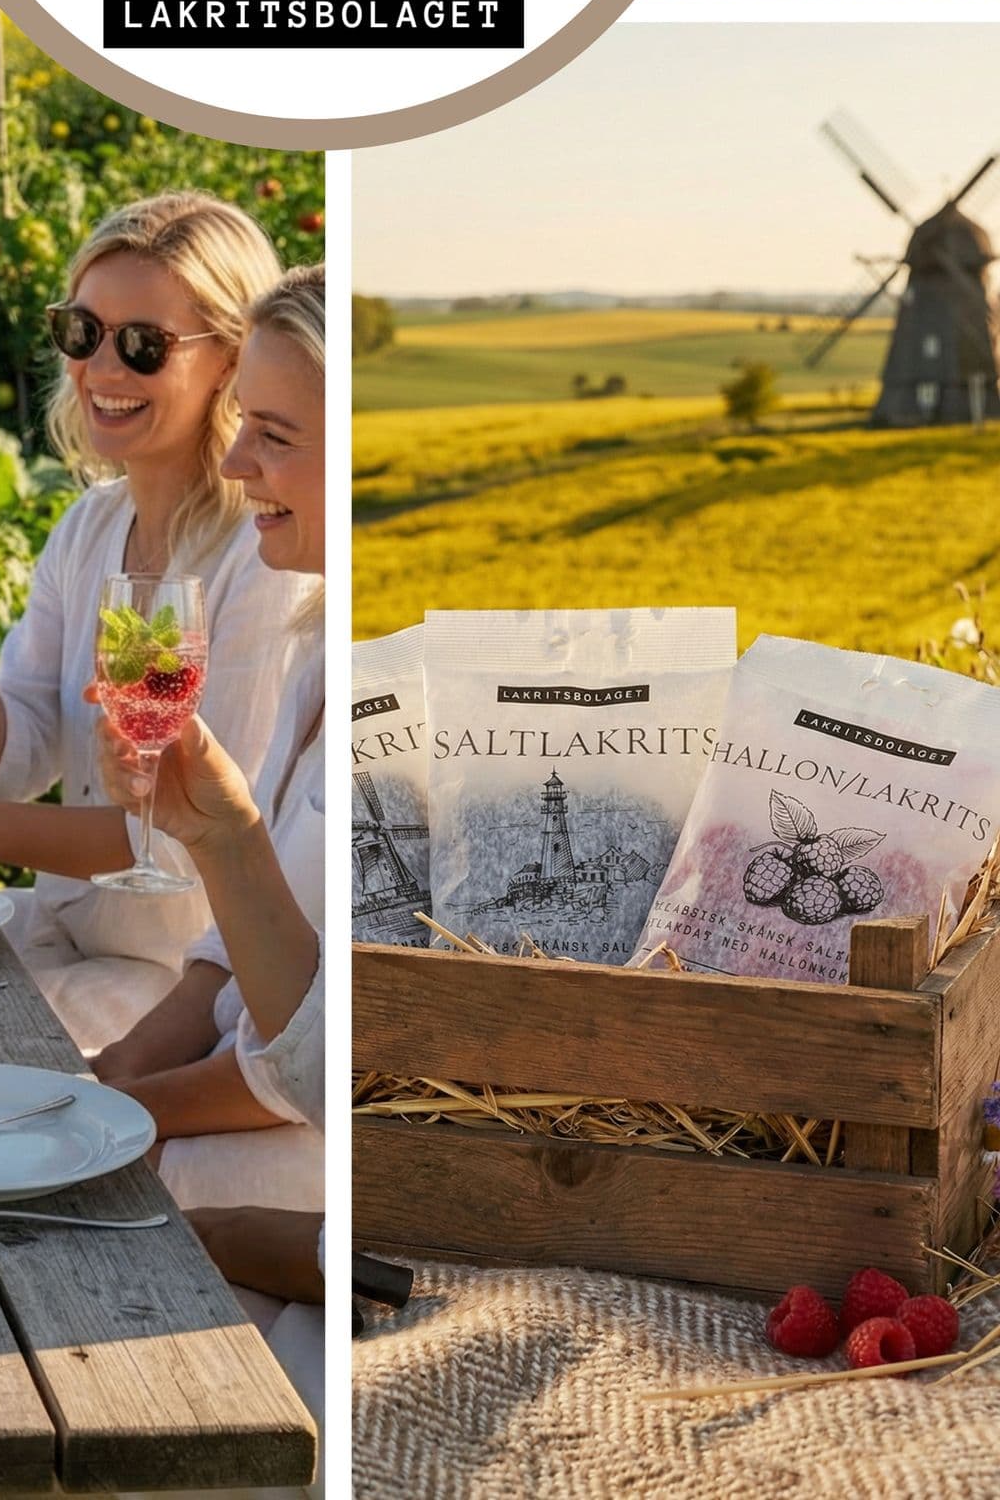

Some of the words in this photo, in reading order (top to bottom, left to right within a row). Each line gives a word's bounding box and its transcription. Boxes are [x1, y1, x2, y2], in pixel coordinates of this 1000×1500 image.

[503, 688, 643, 703] LAKRITSBOLAGET
[352, 698, 392, 717] AGET
[433, 726, 718, 760] SALTLAKRITS
[710, 741, 992, 842] HALLON/LAKRITS
[602, 942, 635, 953] SAL
